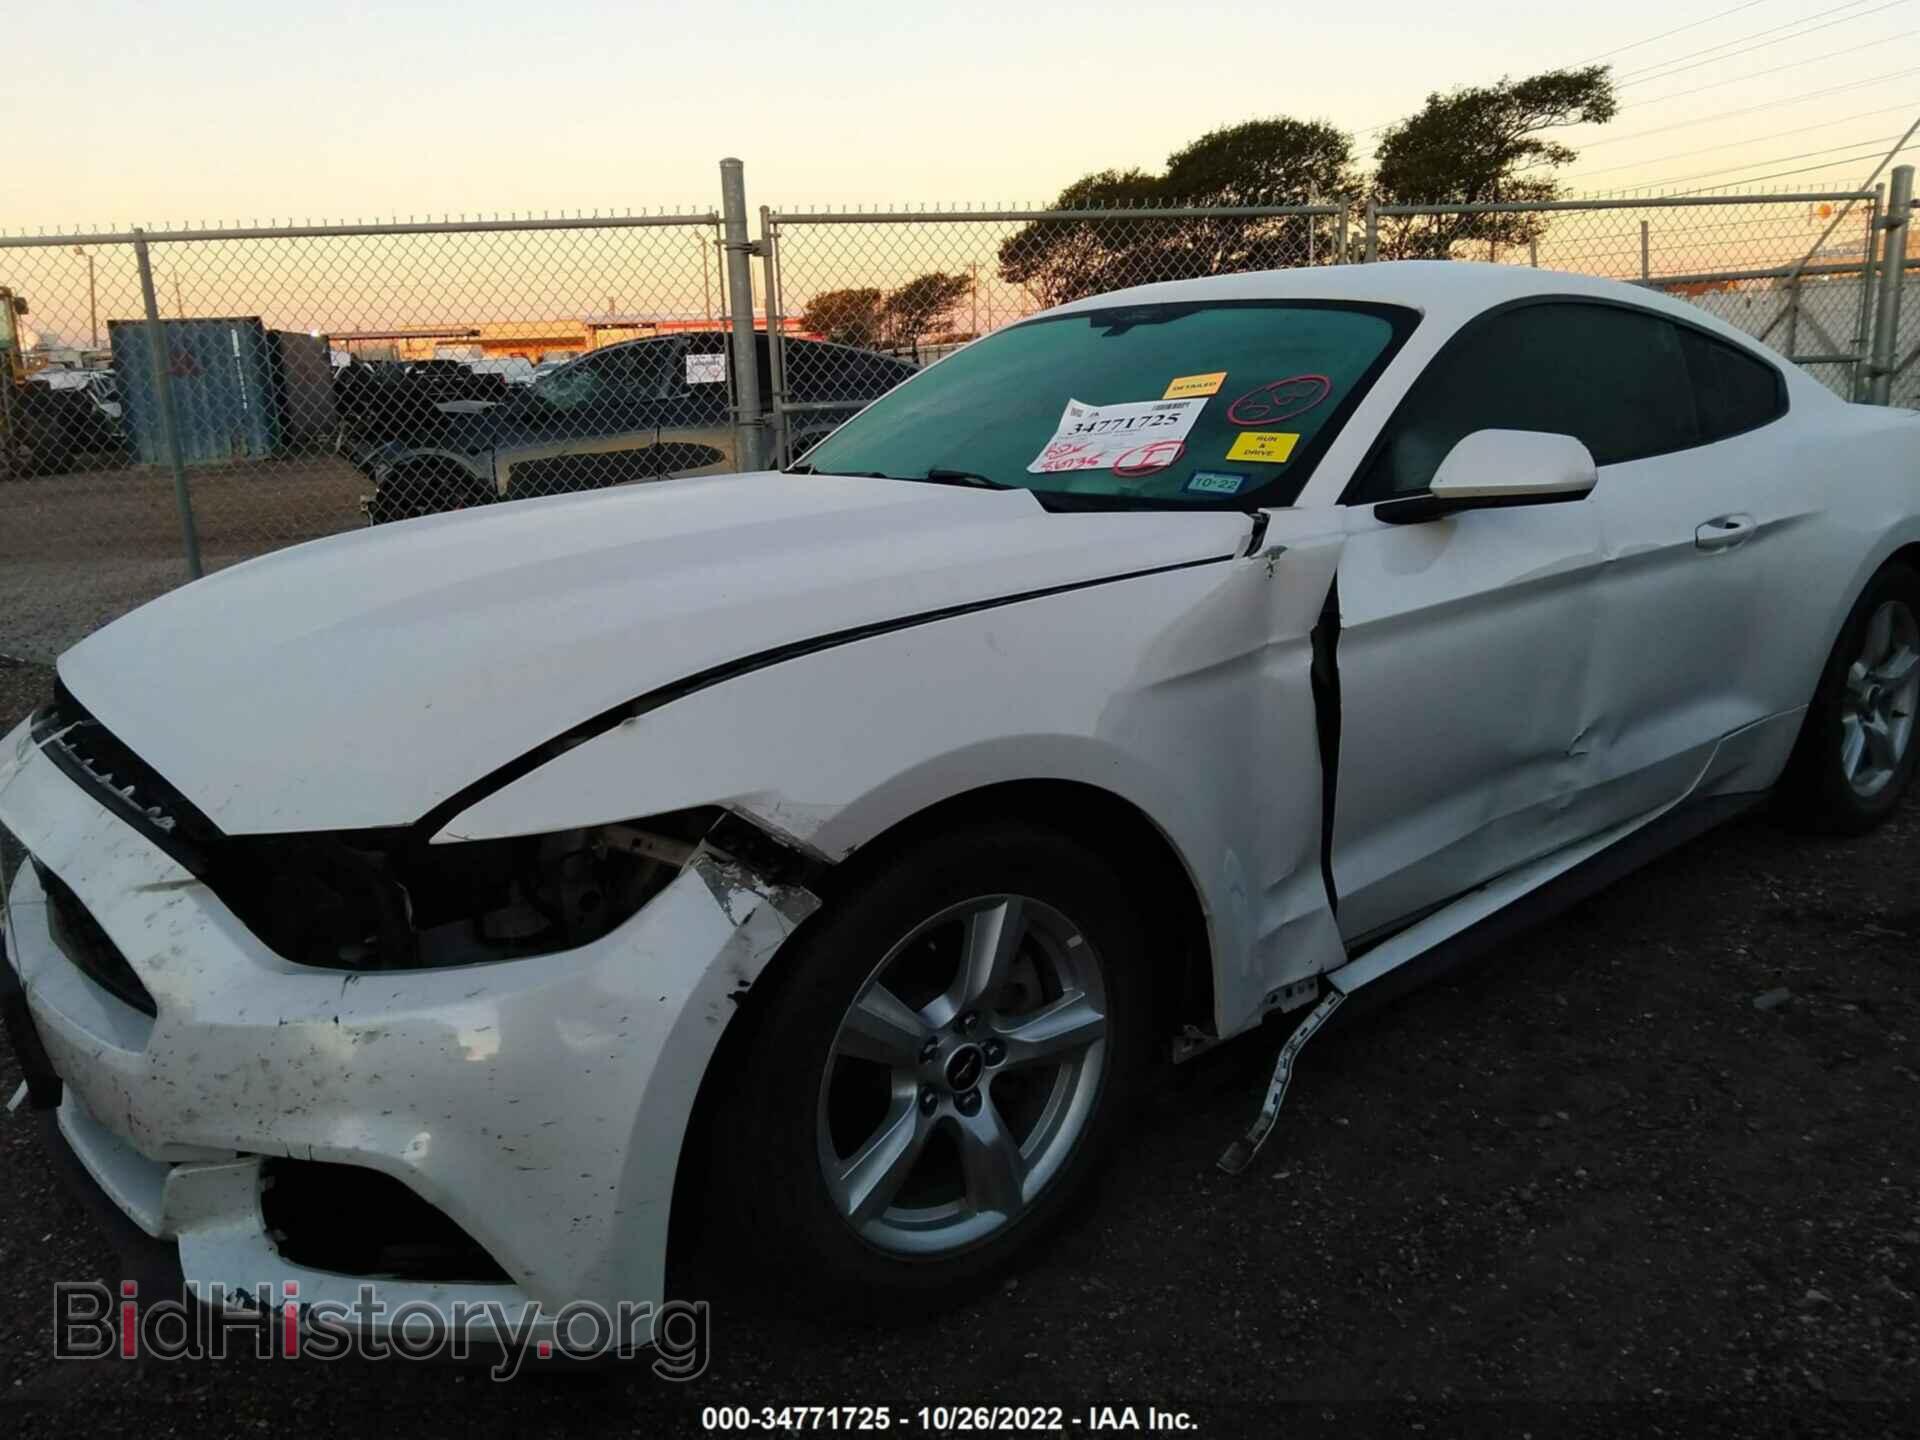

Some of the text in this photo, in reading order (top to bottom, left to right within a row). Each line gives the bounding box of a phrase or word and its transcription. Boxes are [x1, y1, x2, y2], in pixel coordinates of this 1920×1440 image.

[1171, 381, 1217, 391] DETAILED
[1067, 412, 1182, 436] 34771725
[1243, 449, 1275, 457] DRIVE
